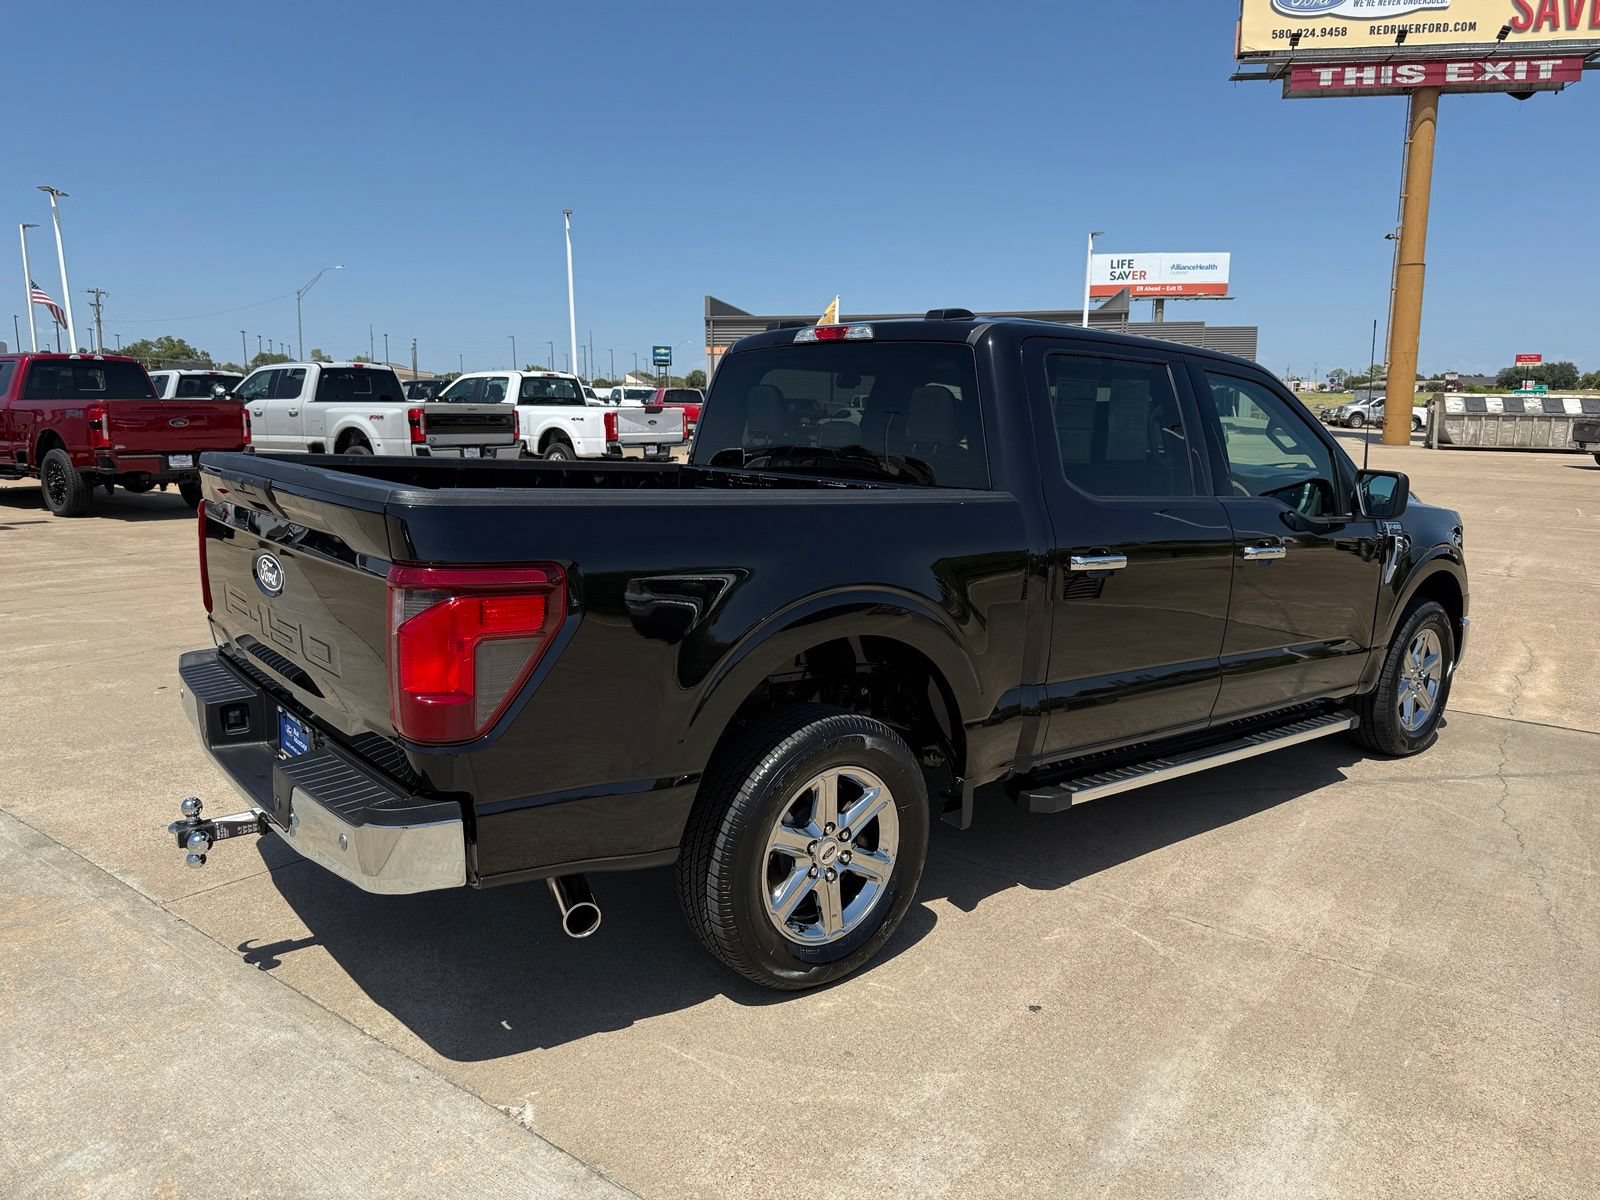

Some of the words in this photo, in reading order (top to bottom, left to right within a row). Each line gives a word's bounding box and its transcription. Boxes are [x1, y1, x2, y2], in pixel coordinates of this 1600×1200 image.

[1272, 27, 1348, 39] 580924.9458
[1369, 22, 1477, 35] REDRIVERFORD.COM
[1312, 65, 1426, 86] THIS
[1445, 60, 1563, 81] EXIT
[1110, 259, 1134, 269] LIFE
[1170, 263, 1218, 271] AllianceHealth
[1109, 270, 1147, 281] SAVER
[260, 558, 279, 587] Ford
